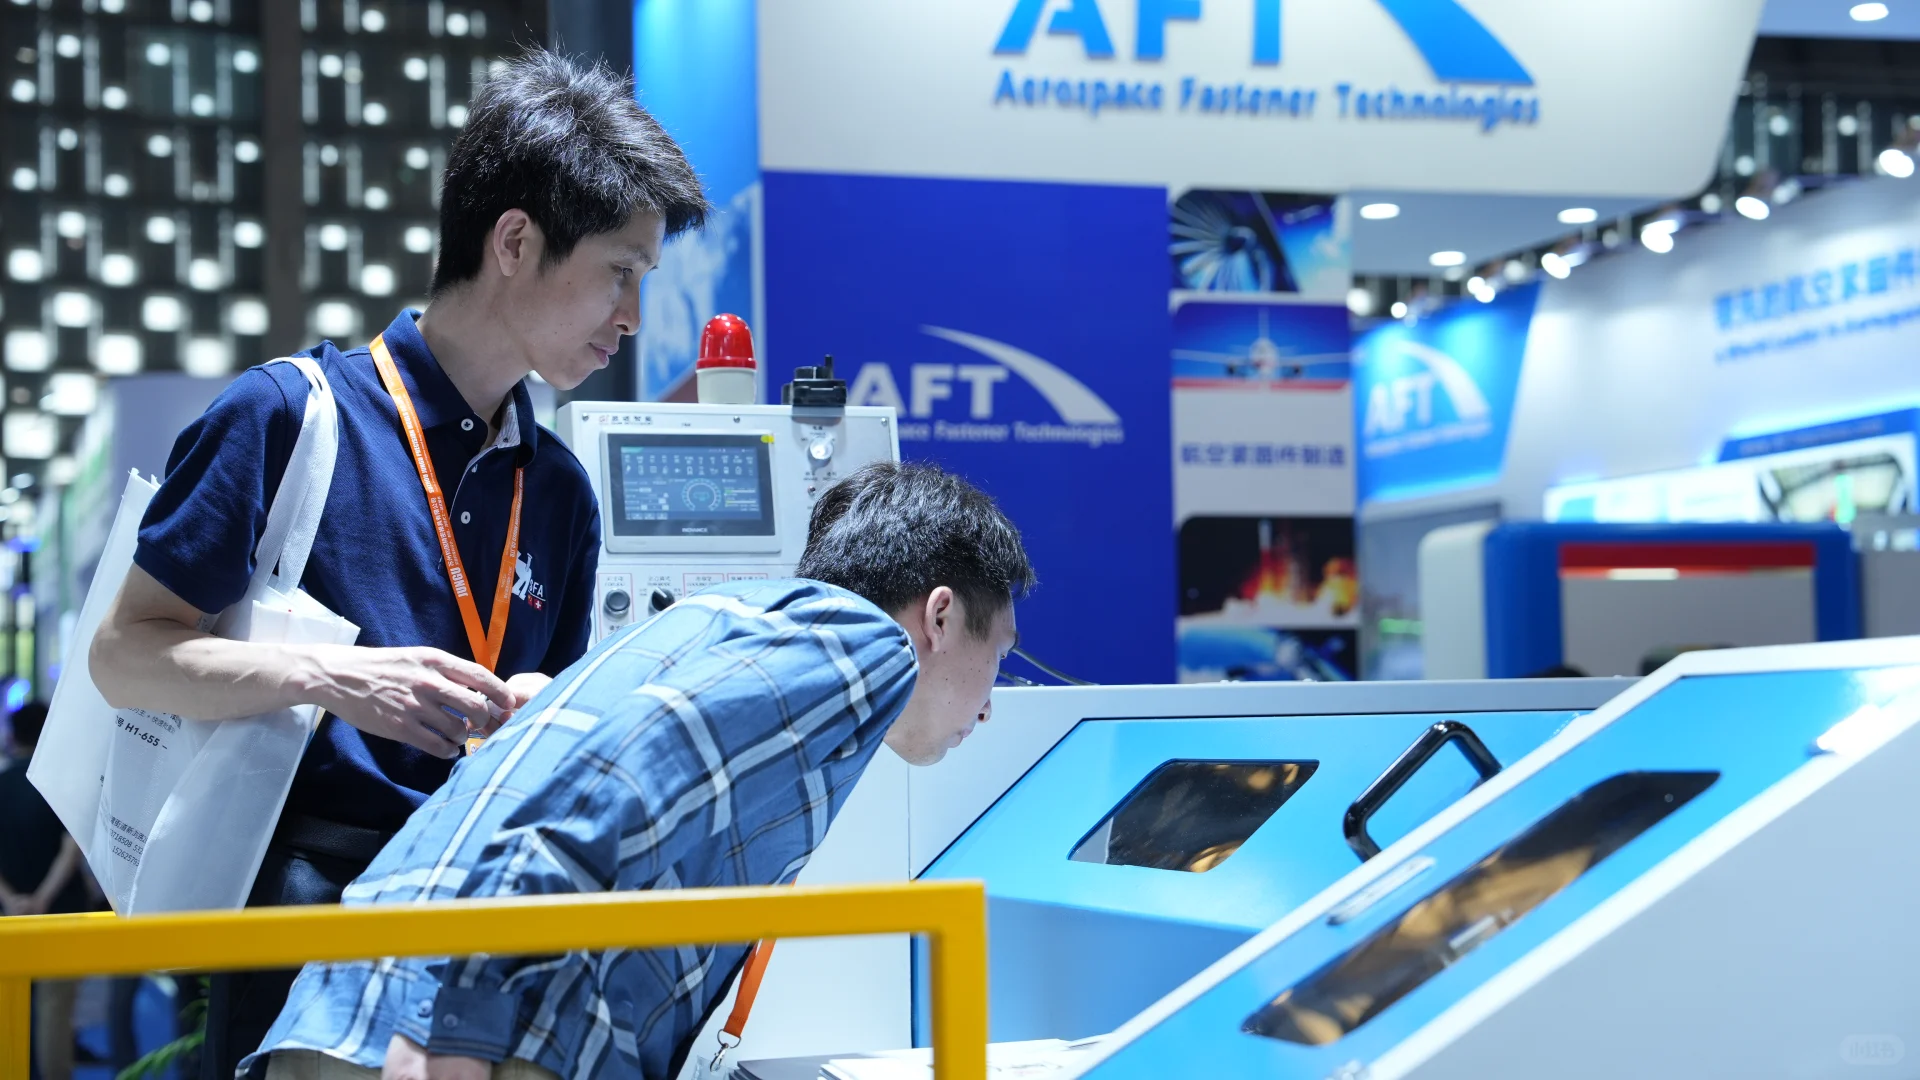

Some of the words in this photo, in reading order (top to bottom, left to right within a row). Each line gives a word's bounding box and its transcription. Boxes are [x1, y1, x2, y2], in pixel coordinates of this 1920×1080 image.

[993, 69, 1163, 117] Aerospace
[1179, 74, 1317, 118] Fastener
[1337, 82, 1540, 133] Technologies
[846, 362, 1009, 419] AFT
[1364, 369, 1435, 436] AFT
[1014, 420, 1125, 448] Technologies
[449, 566, 469, 598] JUNGU
[124, 722, 161, 747] H1-655
